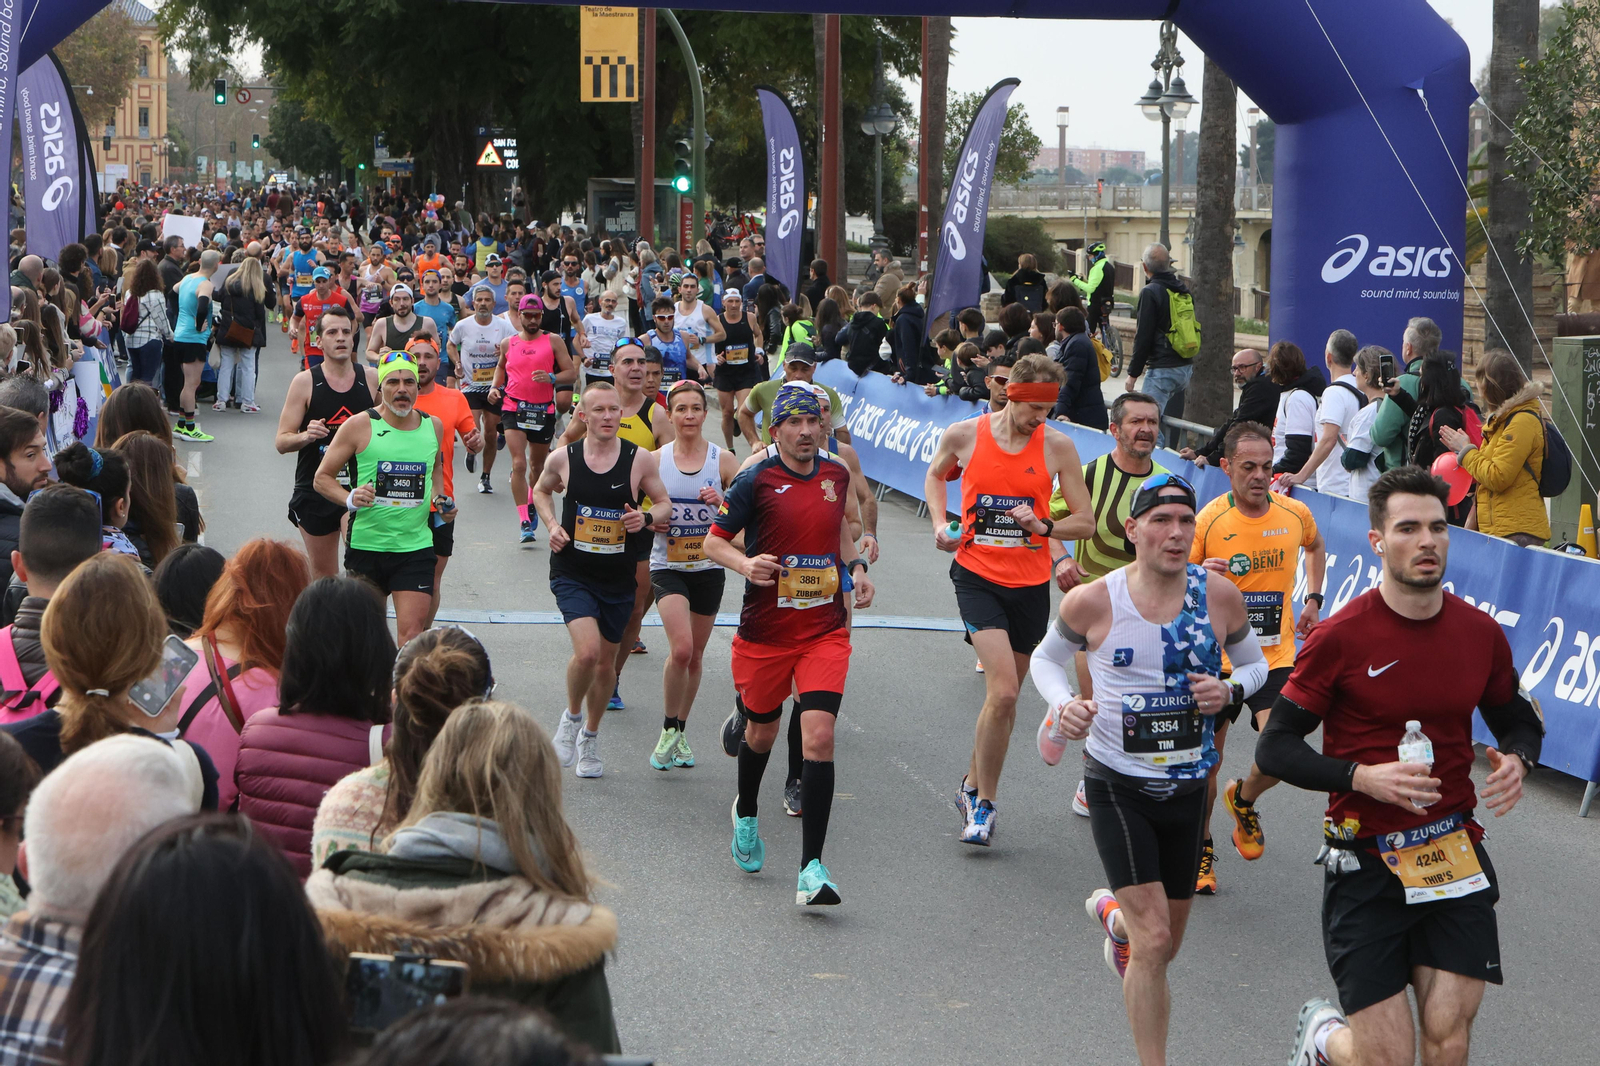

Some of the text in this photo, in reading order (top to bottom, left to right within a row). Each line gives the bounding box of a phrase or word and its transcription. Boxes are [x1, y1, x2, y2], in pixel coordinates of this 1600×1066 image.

[952, 147, 979, 224] asics
[973, 140, 995, 233] sound mind, sound body
[1368, 245, 1452, 278] asics
[1360, 288, 1461, 302] sound mind, sound body
[393, 479, 411, 487] 3450
[996, 498, 1028, 507] ZURICH
[595, 510, 624, 519] ZURICH
[683, 508, 694, 521] &
[697, 508, 709, 521] C
[592, 525, 612, 534] 3718
[985, 528, 1023, 537] ALEXANDER
[1262, 527, 1290, 537] BIKILA
[684, 542, 702, 550] 4458
[1253, 554, 1278, 570] BENI
[799, 575, 820, 585] 3881
[795, 590, 822, 598] ZUBERO
[1244, 594, 1277, 603] ZURICH
[1151, 695, 1195, 708] ZURICH
[1151, 720, 1179, 733] 3354
[1157, 740, 1174, 750] TIM
[1411, 818, 1454, 841] ZURICH
[1416, 849, 1446, 868] 4240
[1422, 871, 1454, 885] THIB'S
